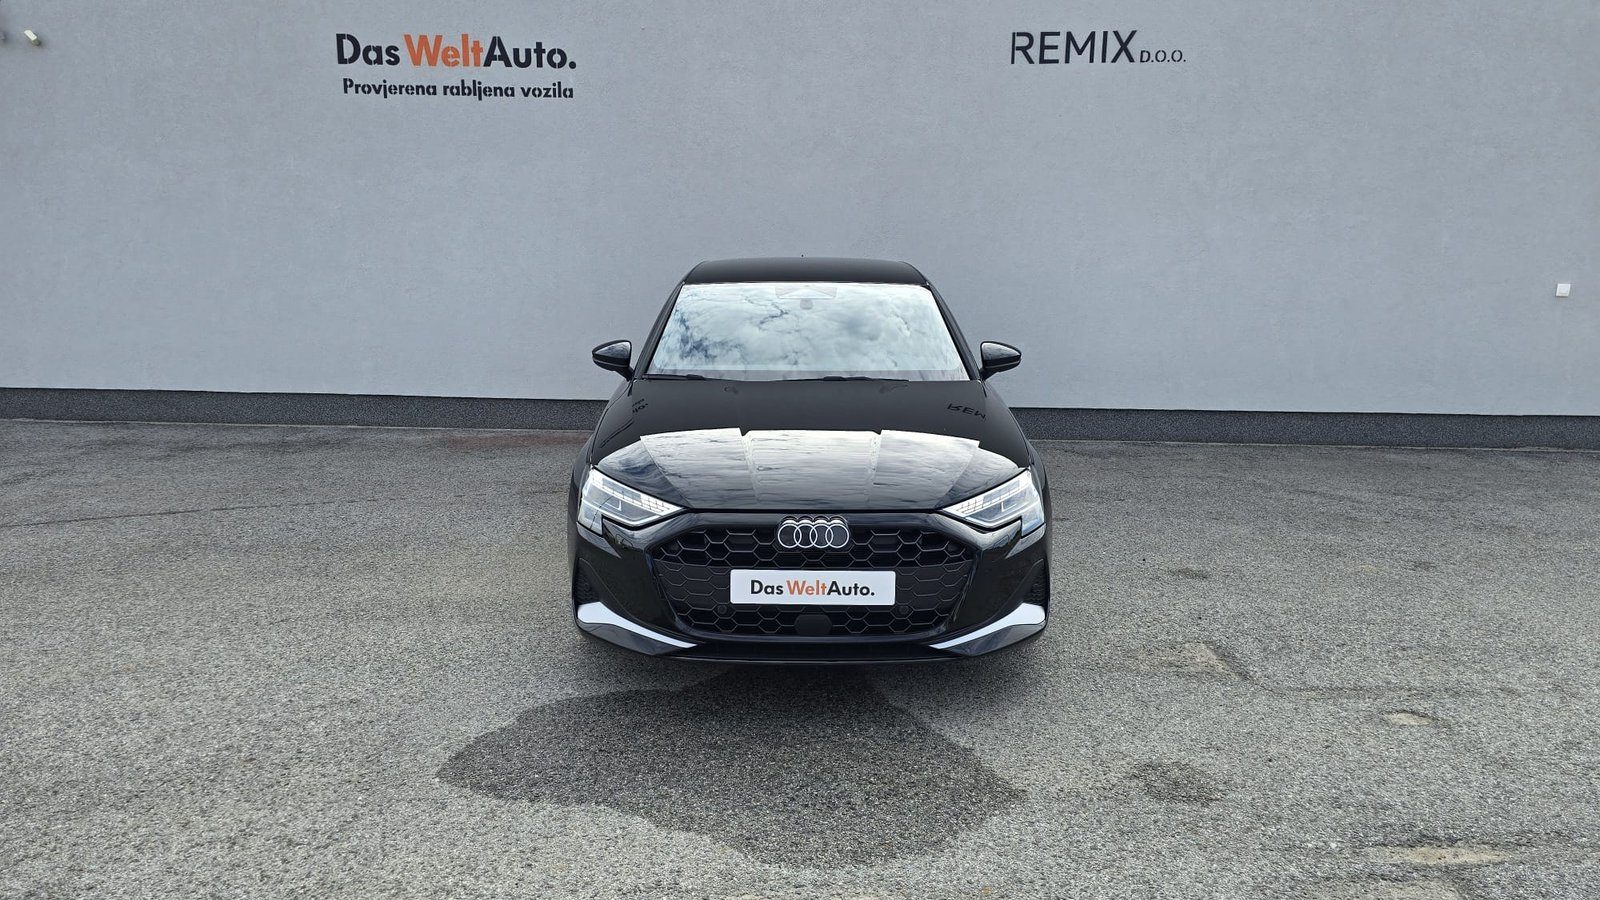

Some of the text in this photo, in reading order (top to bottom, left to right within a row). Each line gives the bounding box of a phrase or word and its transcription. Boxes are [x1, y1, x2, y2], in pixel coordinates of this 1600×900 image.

[336, 33, 577, 69] Das WeltAuto.
[1011, 30, 1186, 64] REMIX D.O.O.
[343, 78, 574, 101] Provjerena rabljena vozila
[751, 579, 875, 596] Das WeltAuto.
